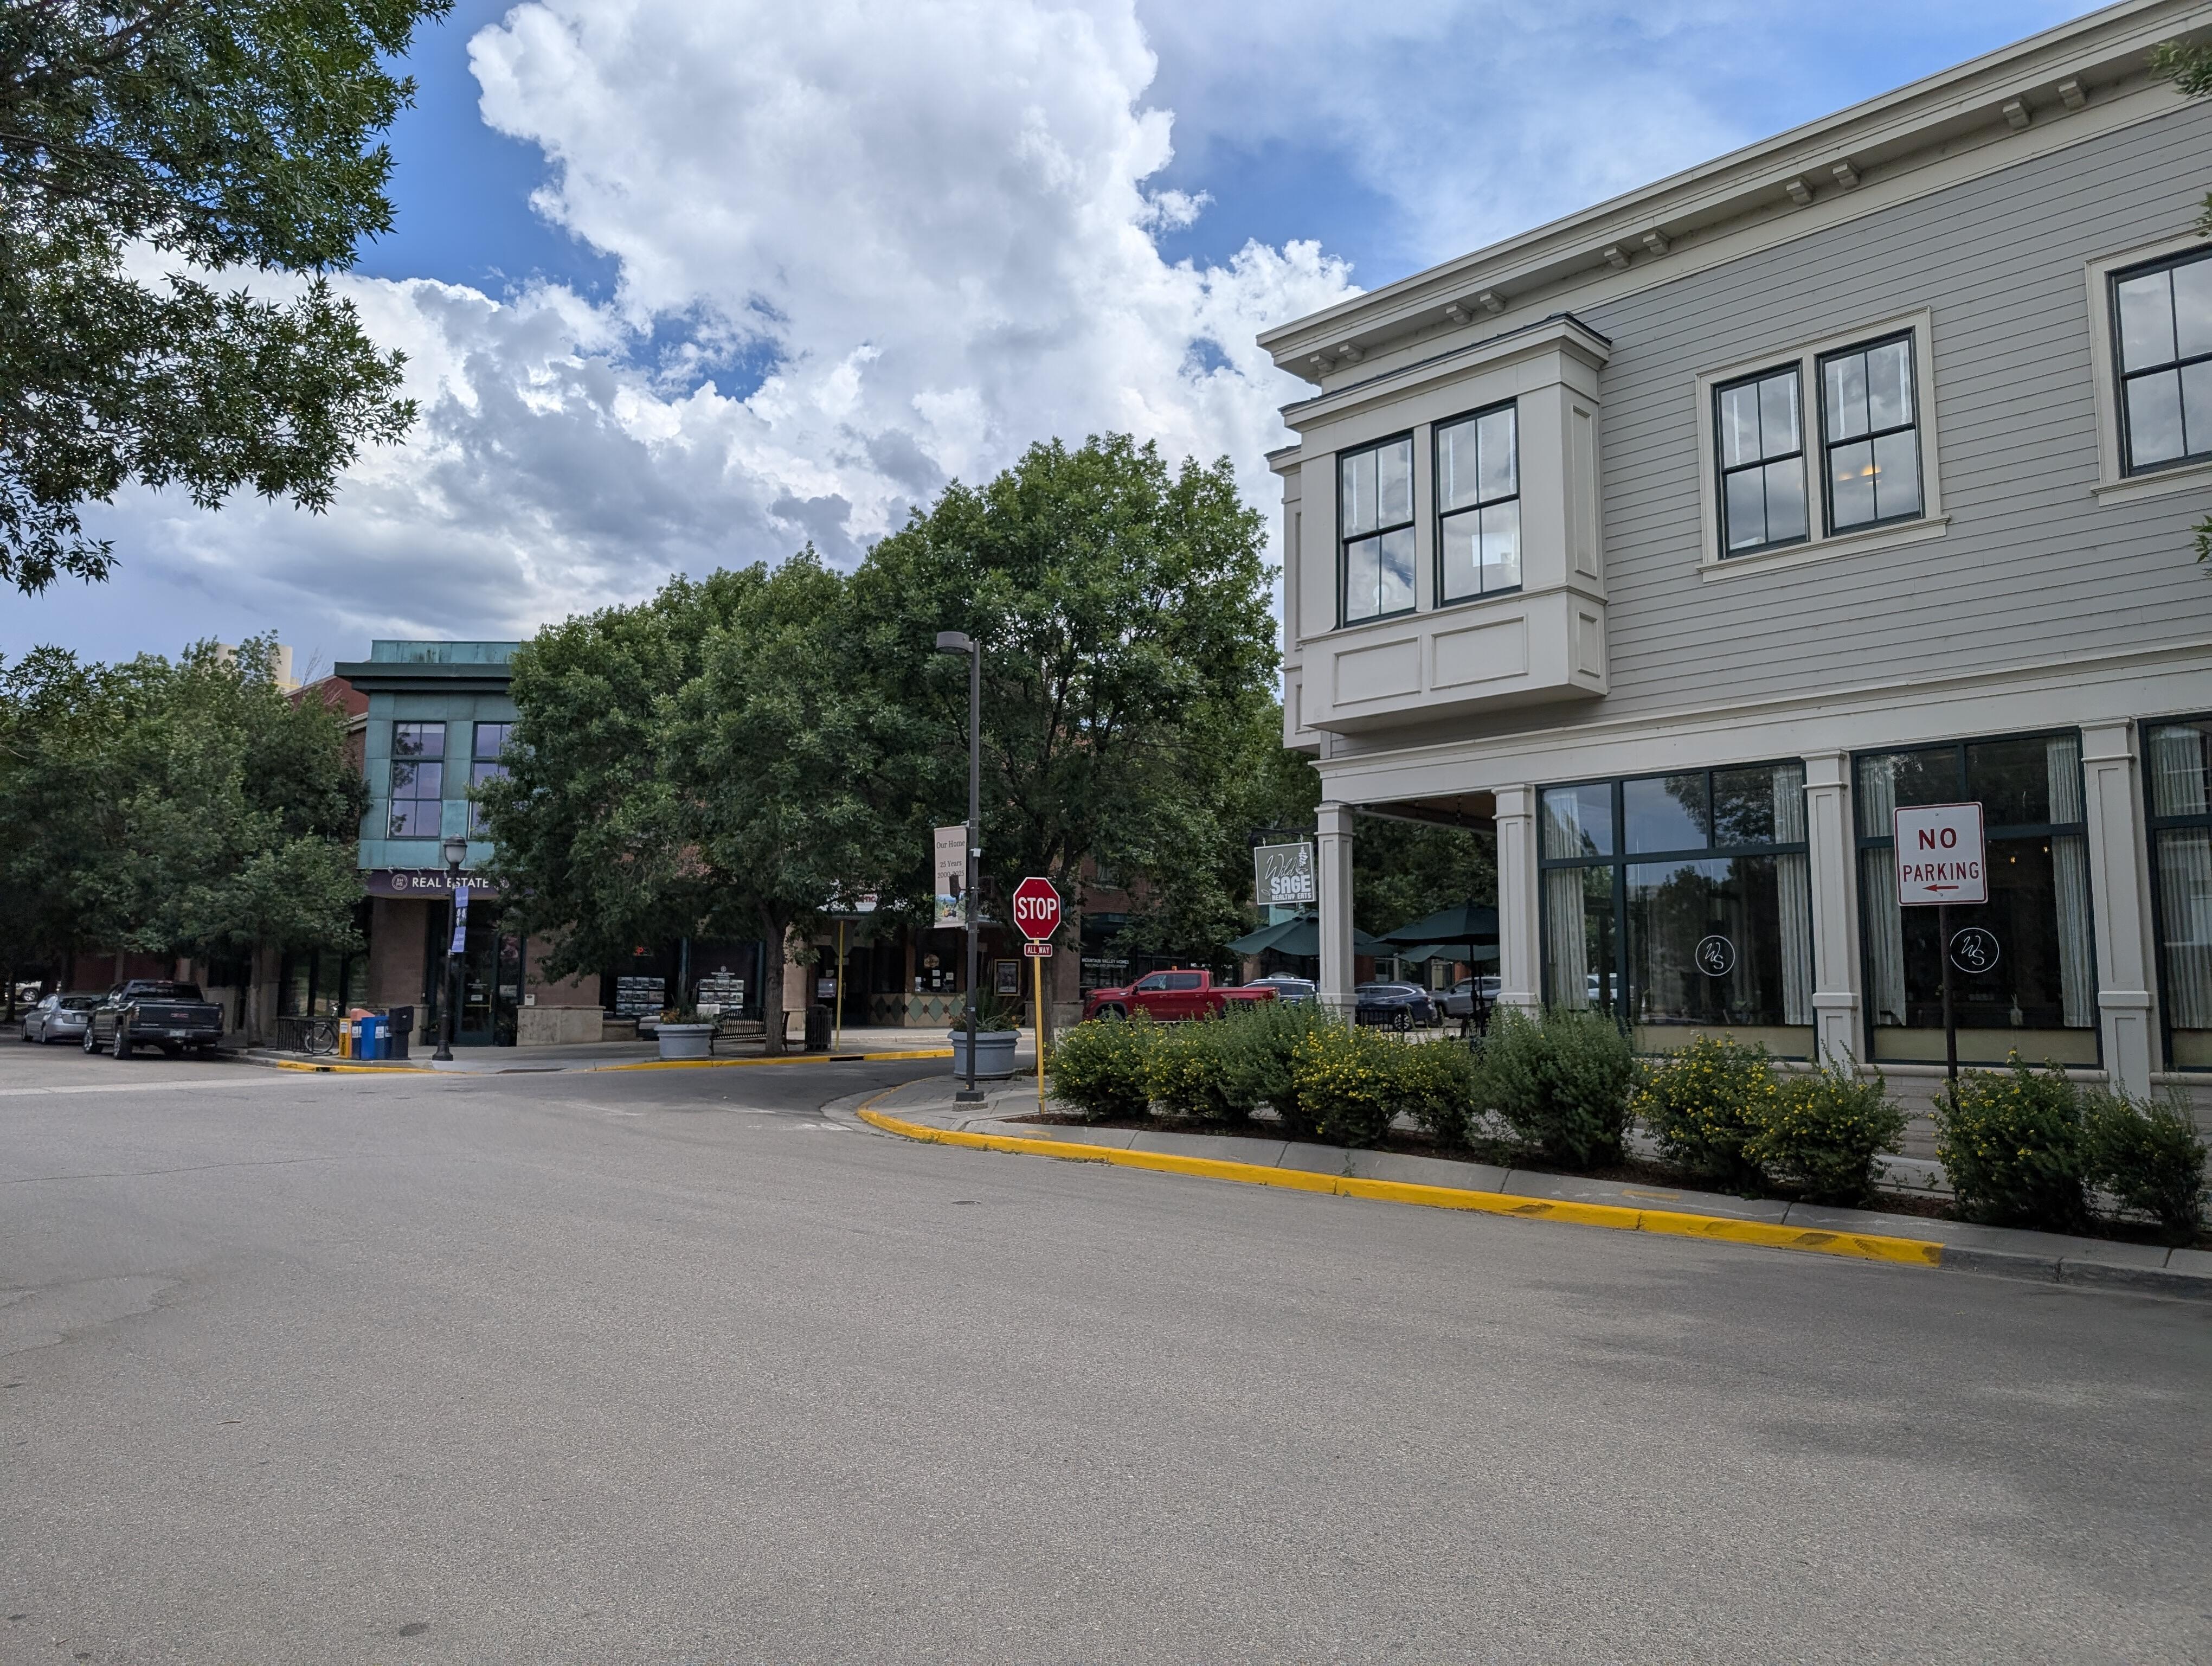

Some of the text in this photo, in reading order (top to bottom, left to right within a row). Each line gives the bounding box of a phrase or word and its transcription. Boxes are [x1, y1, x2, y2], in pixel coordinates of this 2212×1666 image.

[1918, 828, 1957, 850] NO
[1265, 853, 1295, 880] Wild
[1902, 861, 1979, 882] PARKING
[412, 877, 489, 888] REAL ESTATE
[1270, 874, 1311, 895] SAGE
[1017, 896, 1057, 920] STOP
[1027, 946, 1050, 954] ALL WAY
